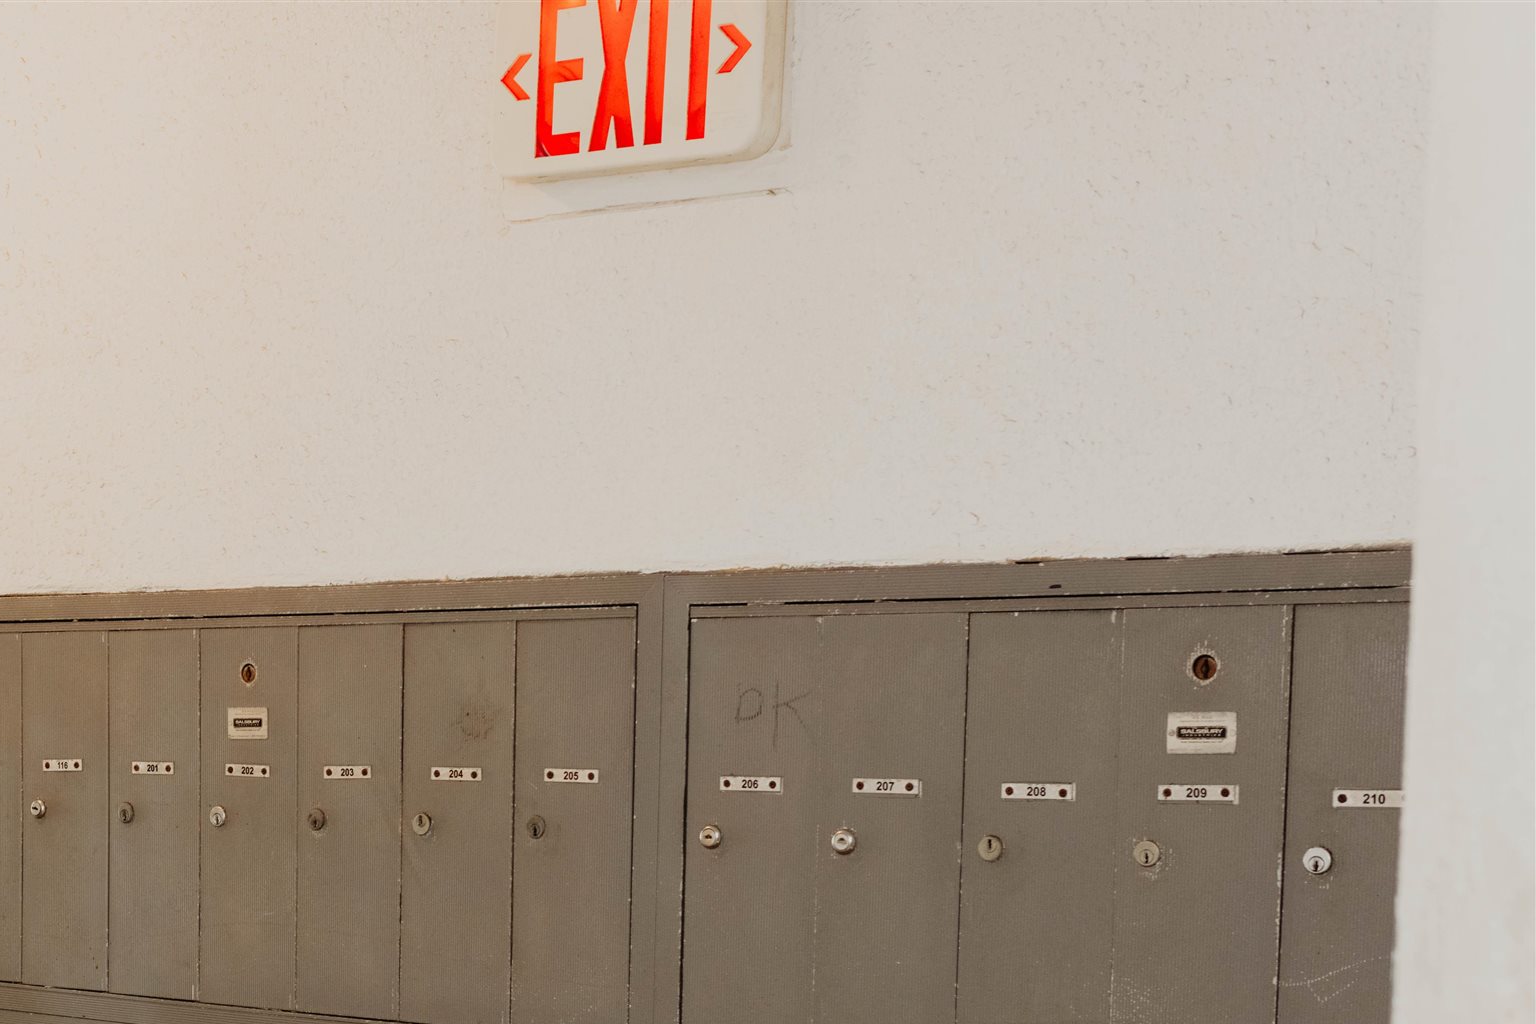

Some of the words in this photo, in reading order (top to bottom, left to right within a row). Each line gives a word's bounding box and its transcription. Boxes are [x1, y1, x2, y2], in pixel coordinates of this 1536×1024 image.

[147, 764, 158, 772] 201
[241, 766, 254, 775] 202
[340, 768, 354, 777] 203
[448, 769, 463, 778] 204
[563, 771, 579, 780] 205
[741, 779, 759, 789] 206
[876, 781, 894, 791] 207
[1026, 787, 1046, 797] 208
[1186, 788, 1207, 798] 209
[1362, 793, 1386, 805] 210
